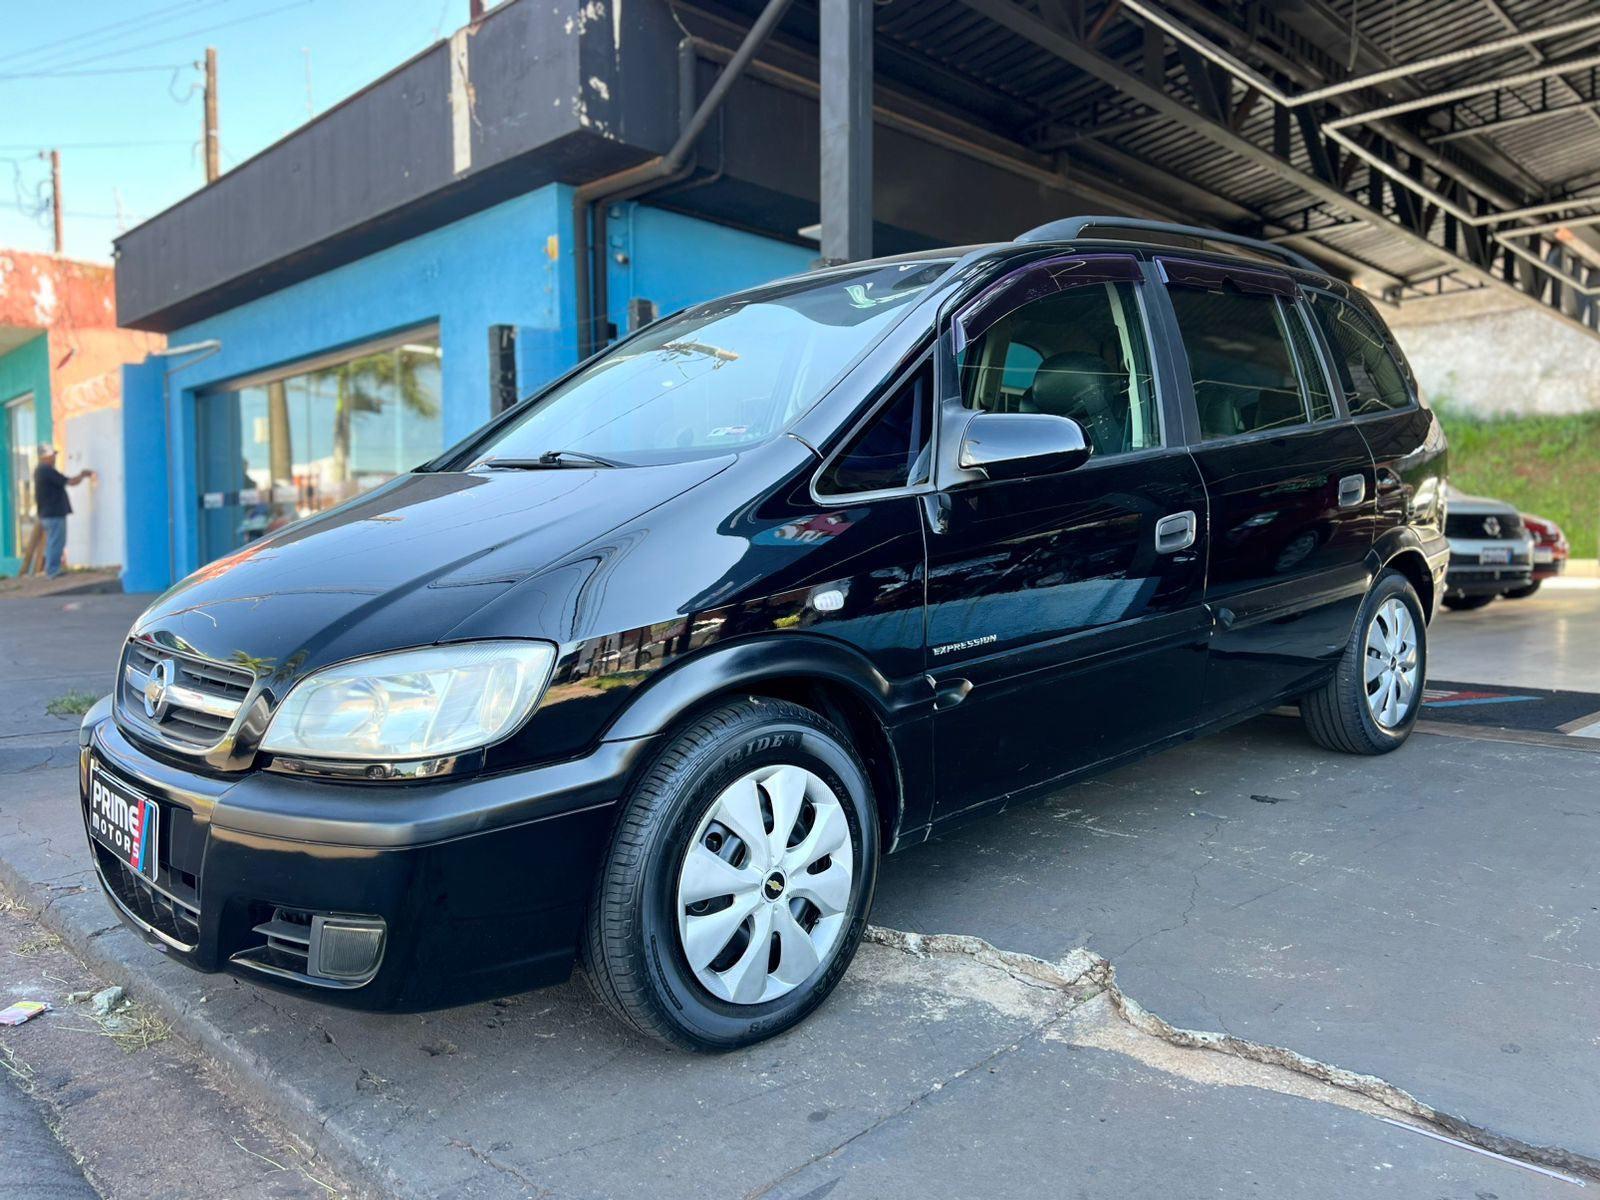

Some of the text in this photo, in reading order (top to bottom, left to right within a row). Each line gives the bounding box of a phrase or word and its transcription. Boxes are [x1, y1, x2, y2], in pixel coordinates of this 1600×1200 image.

[932, 634, 997, 656] EXPRESSION
[92, 780, 140, 838] PRIME
[92, 812, 140, 858] MOTORS
